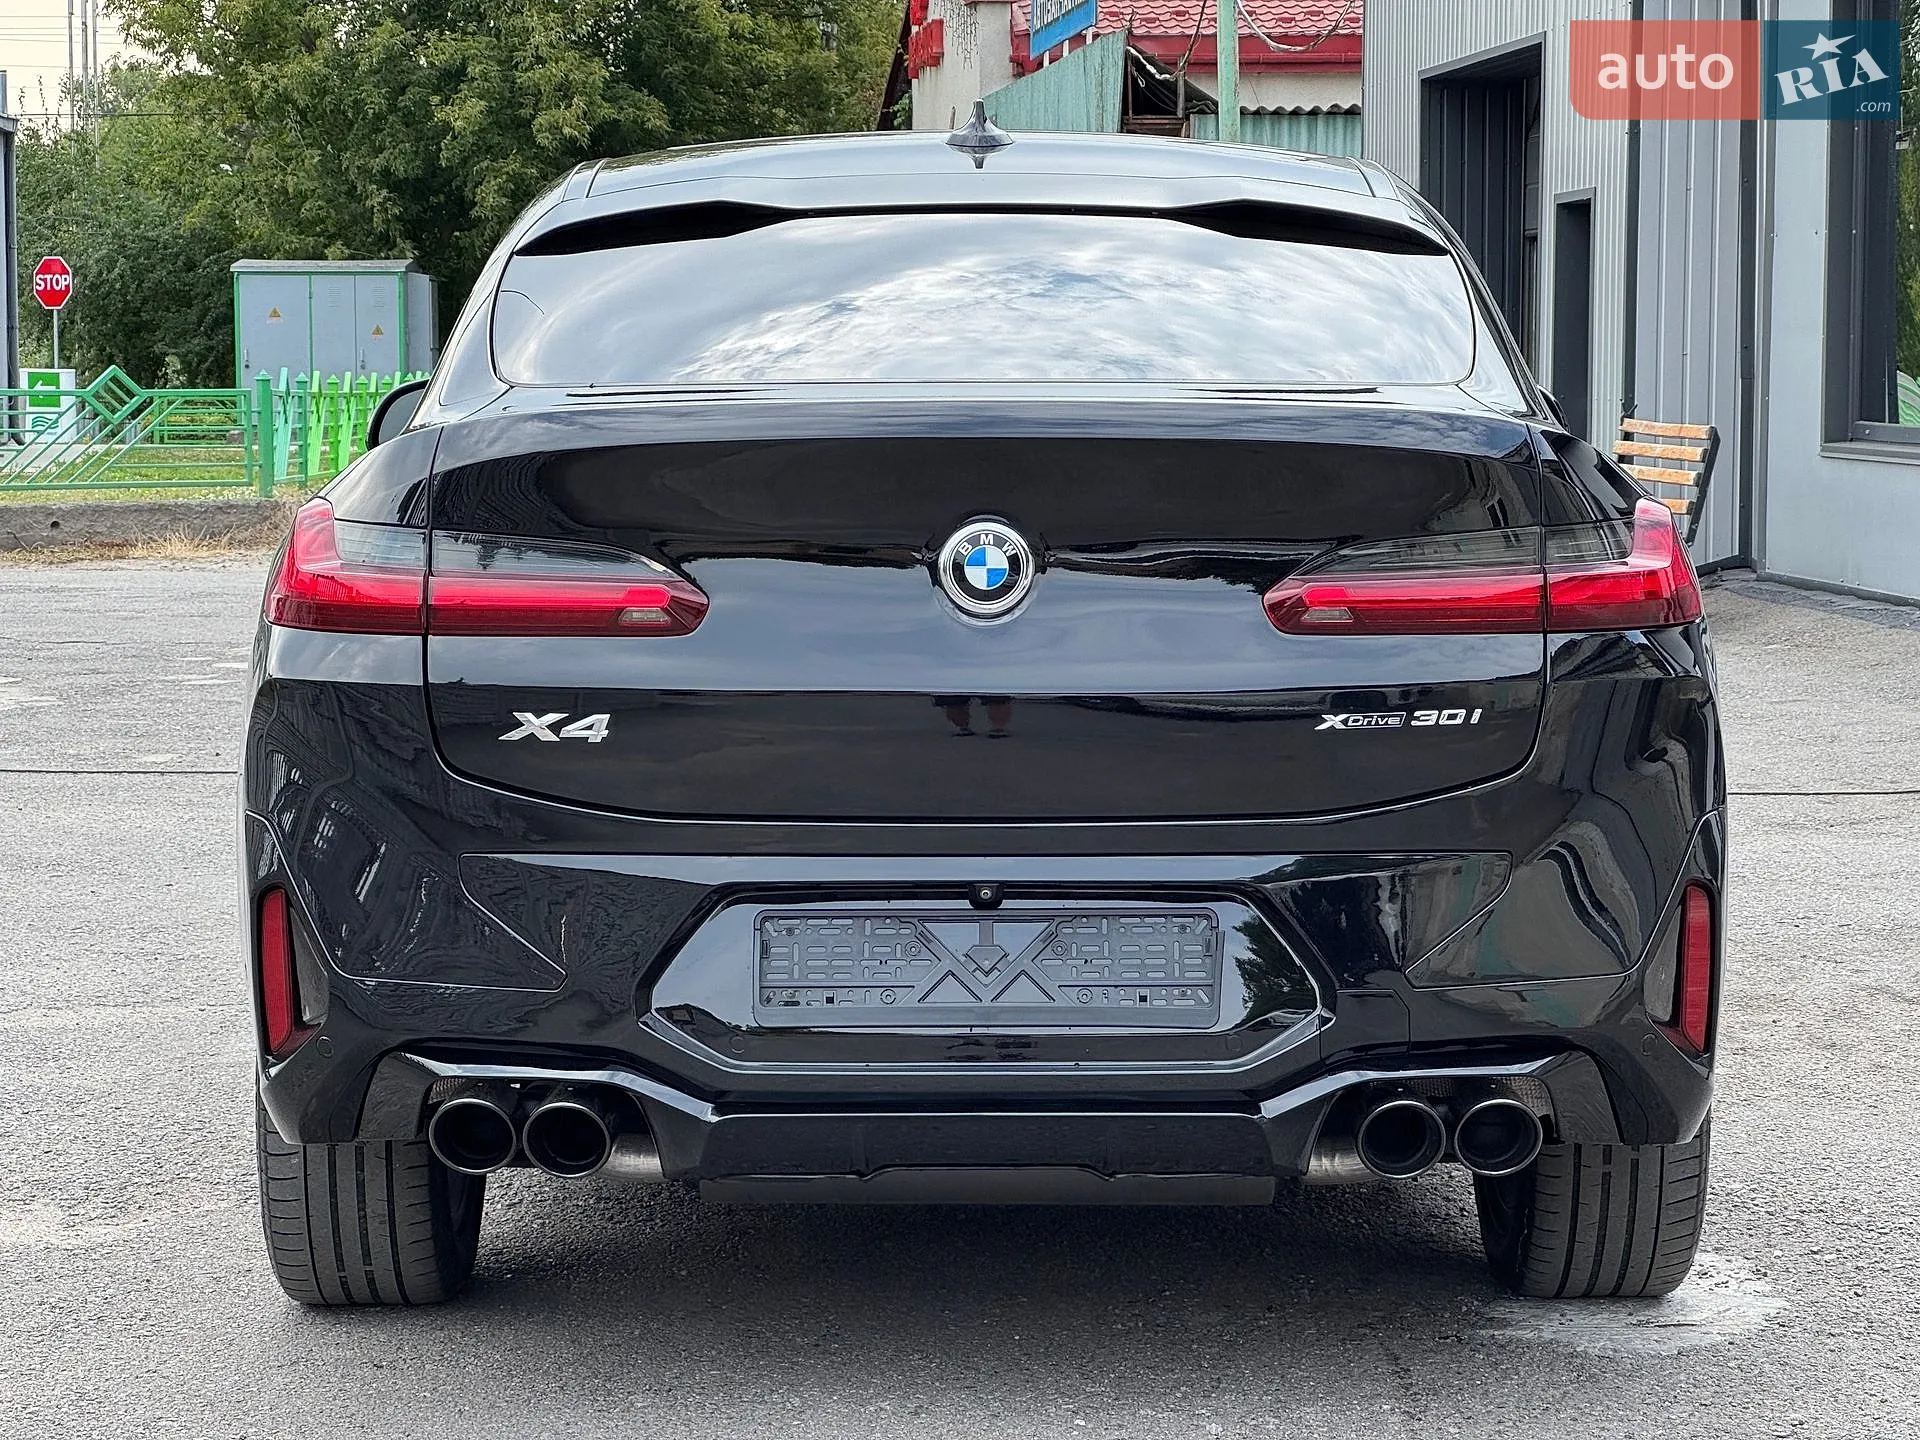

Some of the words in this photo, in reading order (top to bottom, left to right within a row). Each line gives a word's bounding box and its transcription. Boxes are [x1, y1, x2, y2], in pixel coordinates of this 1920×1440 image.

[35, 274, 70, 291] STOP
[958, 534, 1016, 556] BMW
[498, 712, 610, 742] X4
